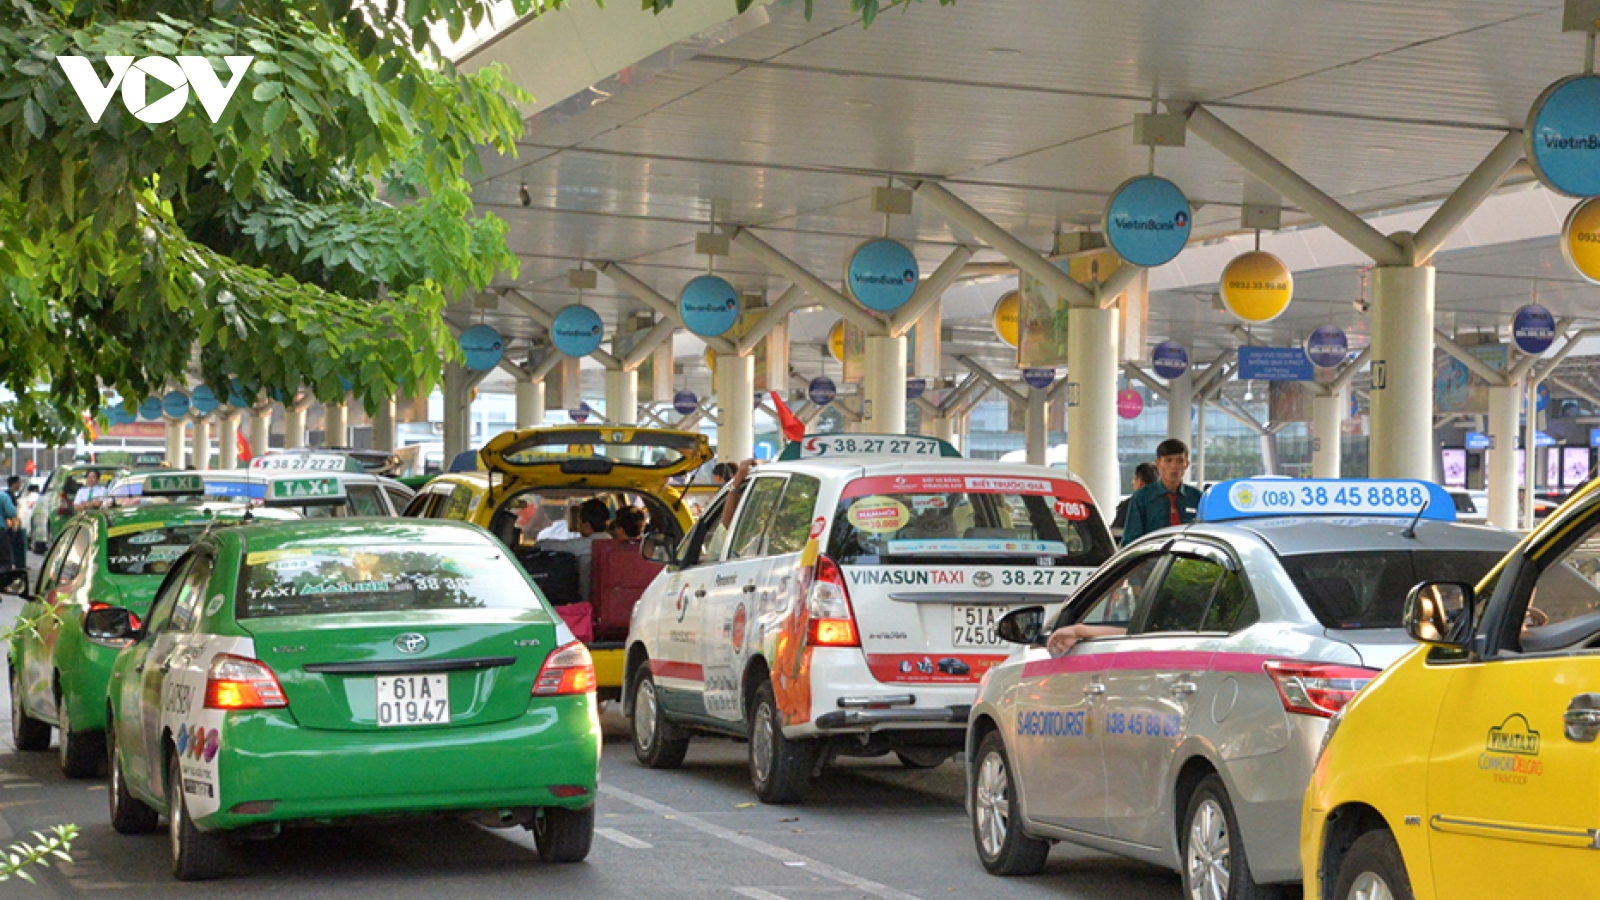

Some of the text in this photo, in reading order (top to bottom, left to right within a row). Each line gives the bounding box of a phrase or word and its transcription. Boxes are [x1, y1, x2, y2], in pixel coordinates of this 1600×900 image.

[1115, 217, 1175, 232] VietinBank
[833, 438, 938, 455] 38.27 27 27
[272, 459, 343, 469] 38 27 27 27
[157, 477, 193, 491] TAXI
[1261, 486, 1424, 507] (08) 38 45 8888
[1057, 501, 1086, 518] 7061
[109, 553, 146, 564] TAXI
[1001, 569, 1055, 587] 38.27
[1060, 570, 1080, 587] 27
[248, 587, 296, 599] TAXI
[965, 606, 996, 626] 51A
[954, 625, 1003, 646] 745.0
[392, 677, 432, 700] 61A
[379, 699, 447, 724] 019.47
[1016, 710, 1087, 737] SAIGONTOURIST
[1127, 713, 1143, 735] 45
